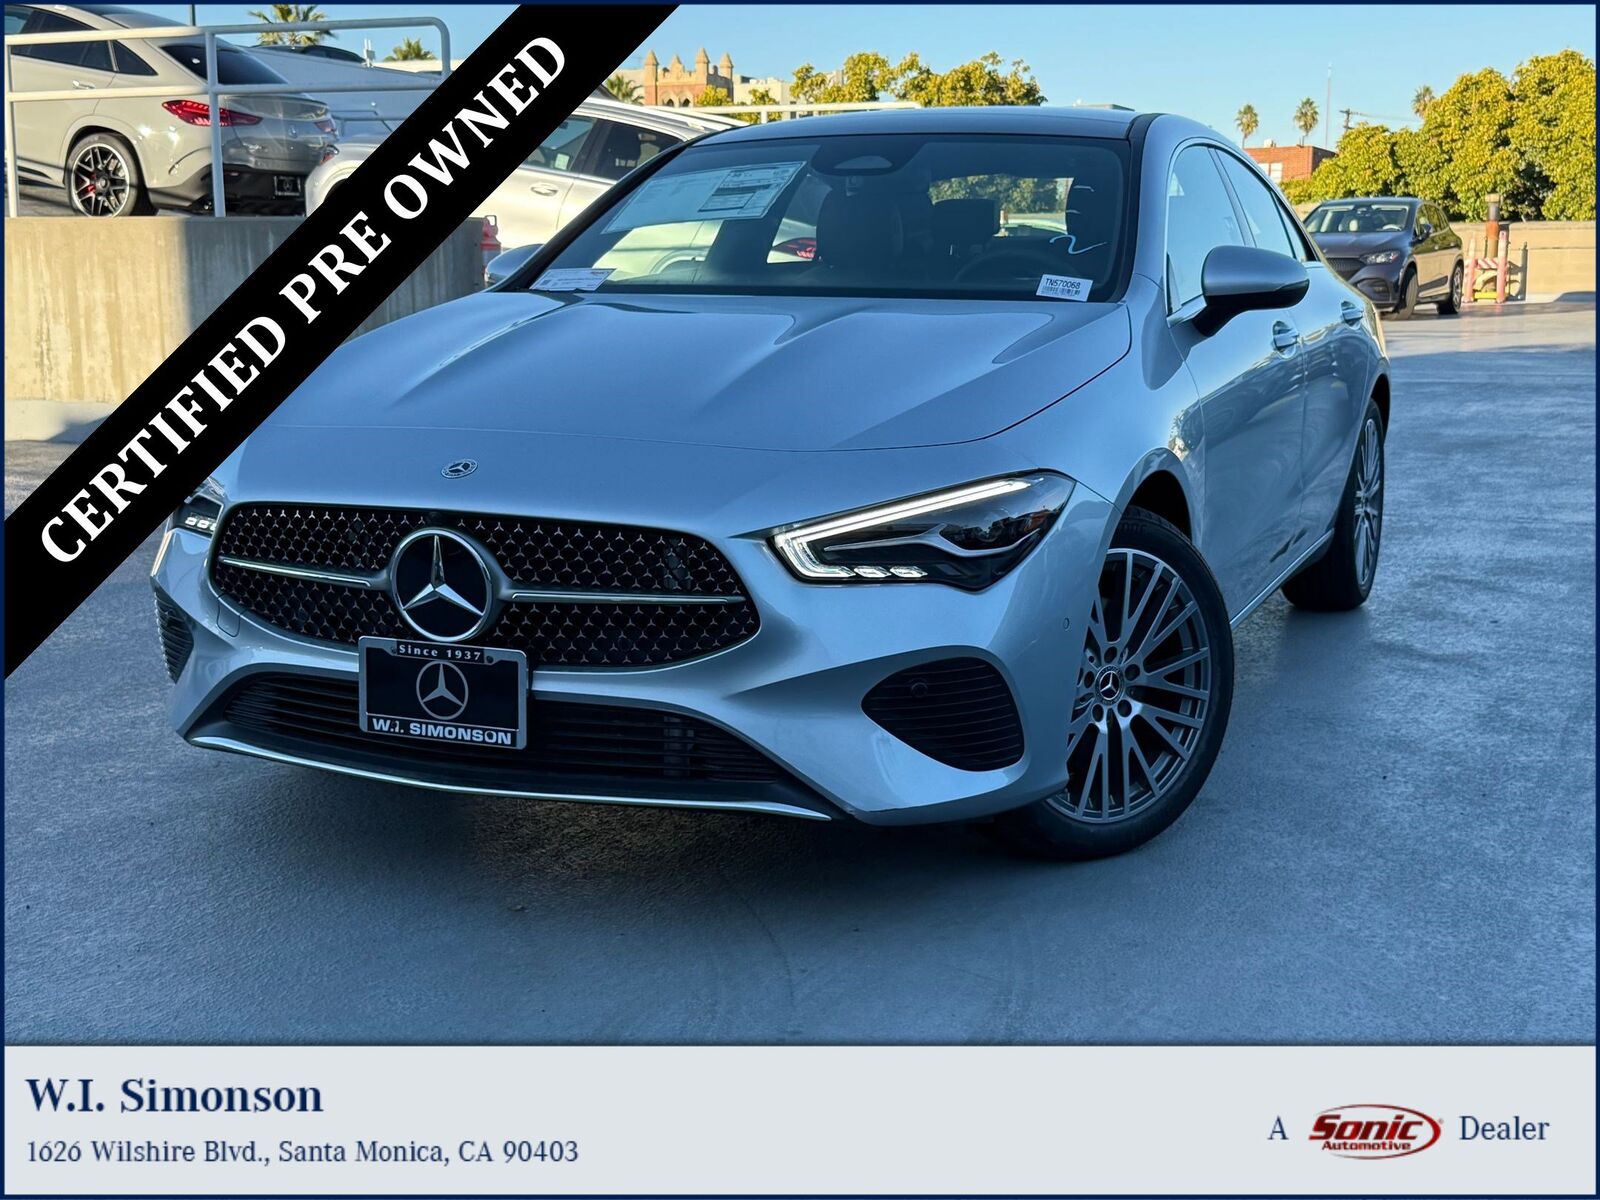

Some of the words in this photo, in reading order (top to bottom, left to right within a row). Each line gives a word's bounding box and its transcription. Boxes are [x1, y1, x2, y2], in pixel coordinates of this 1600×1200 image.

[1045, 278, 1081, 290] TN570068
[399, 644, 439, 658] Since
[446, 648, 482, 662] 1937
[409, 723, 512, 745] SIMONSON
